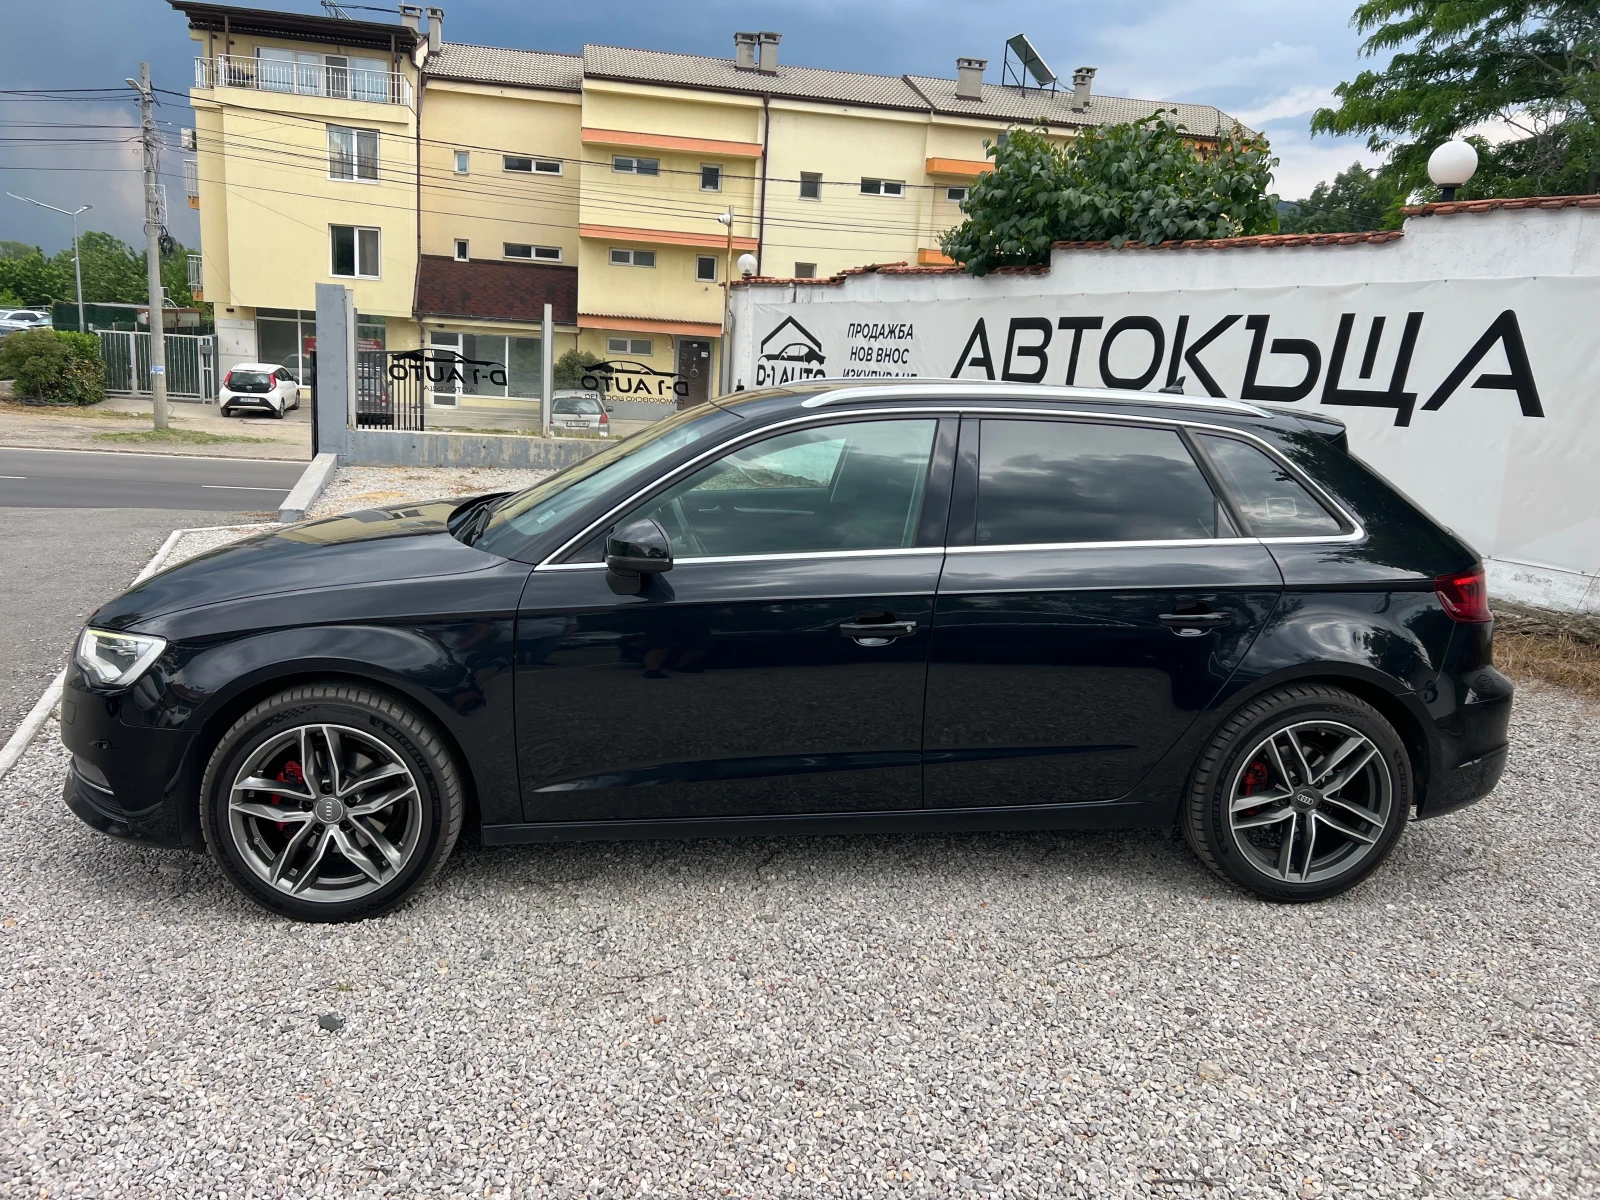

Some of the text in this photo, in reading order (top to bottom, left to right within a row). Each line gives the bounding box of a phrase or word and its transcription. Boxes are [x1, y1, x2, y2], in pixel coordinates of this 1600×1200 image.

[847, 323, 914, 341] ПРОДАЖБА
[850, 346, 910, 364] НОВ ВНОС
[756, 364, 776, 386] D-1
[951, 309, 1545, 427] АВТОКЪЩА
[385, 726, 431, 775] MICHELIN
